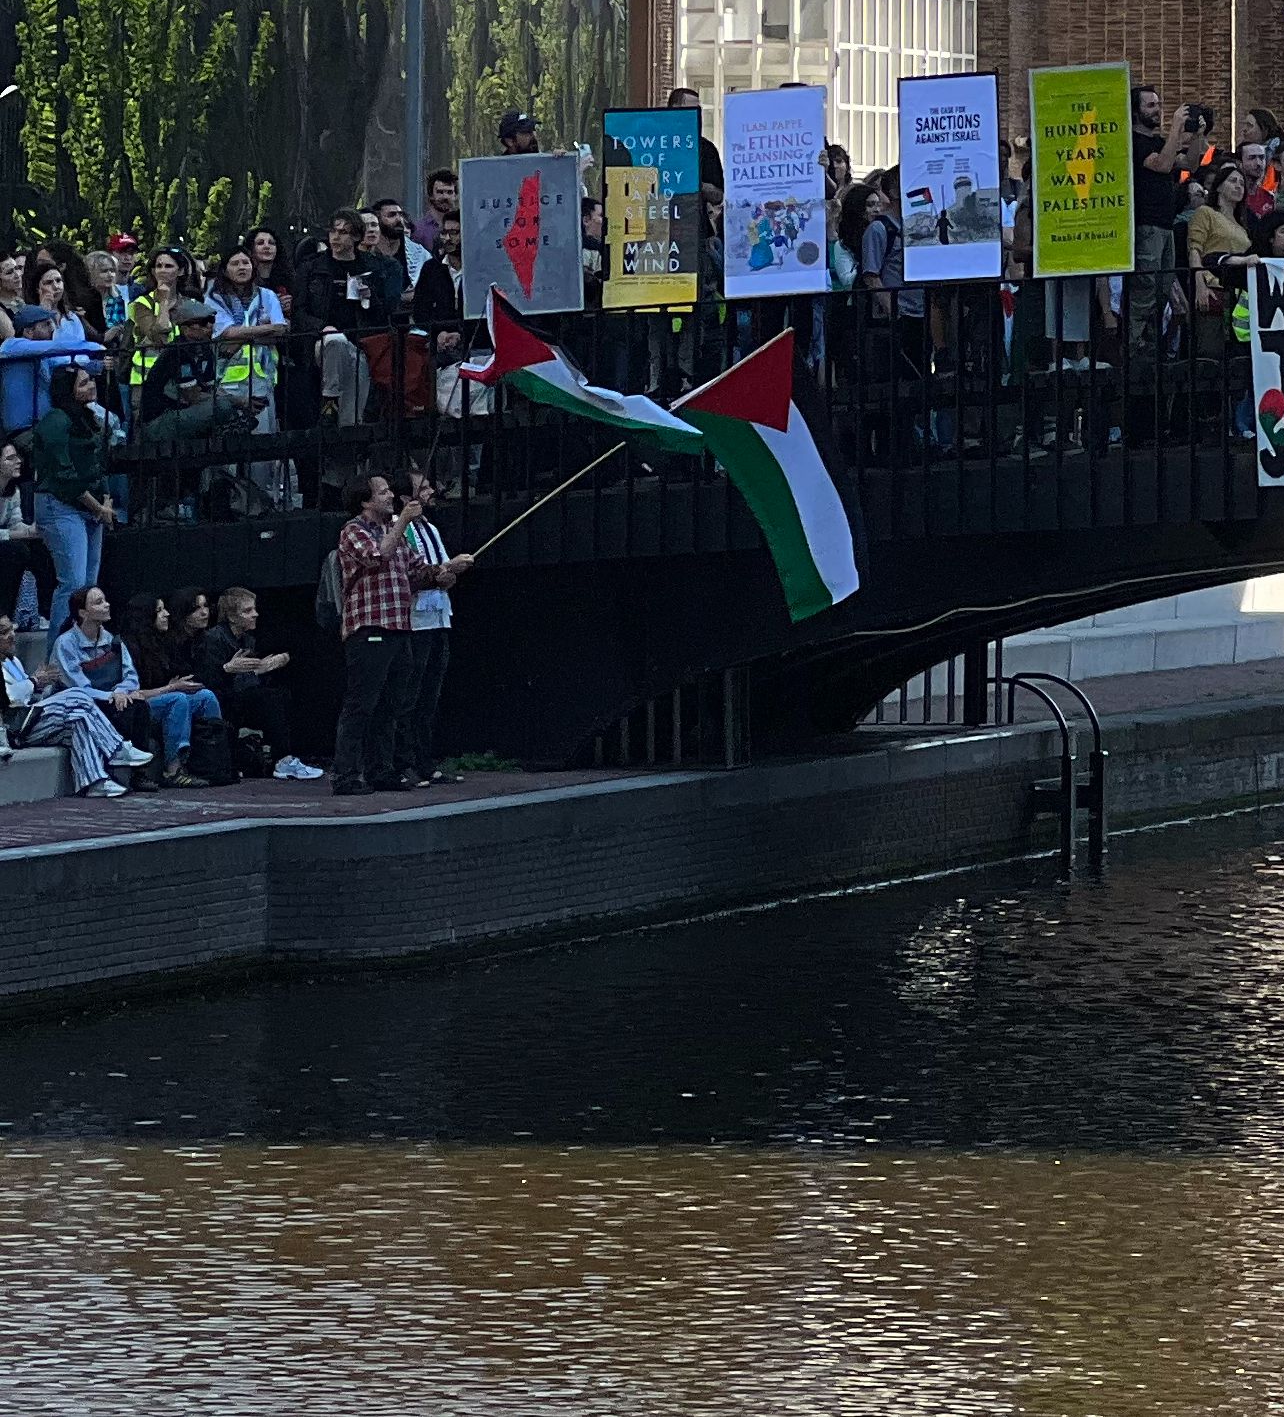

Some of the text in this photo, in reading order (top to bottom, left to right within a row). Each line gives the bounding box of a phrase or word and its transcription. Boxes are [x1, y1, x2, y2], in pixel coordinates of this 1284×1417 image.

[1071, 102, 1093, 113] THE
[741, 121, 768, 133] ILAN
[915, 113, 981, 133] SANCTIONS
[1044, 121, 1119, 138] HUNDRED
[611, 134, 695, 150] TOWERS
[748, 132, 813, 151] ETHNIC
[915, 130, 982, 145] AGAINST ISRAEL
[640, 153, 666, 167] OF
[732, 148, 815, 165] CLEANSING of
[1055, 147, 1106, 162] YEARS
[622, 171, 684, 184] IVORY
[732, 162, 814, 182] PALESTINE
[1051, 171, 1117, 187] WAR ON
[480, 194, 564, 209] JUSTICE
[631, 188, 675, 202] AND
[1043, 195, 1126, 213] PALESTINE
[625, 206, 682, 221] STEEL
[504, 216, 541, 228] FOR
[496, 235, 550, 249] SOME
[625, 241, 680, 255] MAYA
[623, 258, 680, 273] WIND
